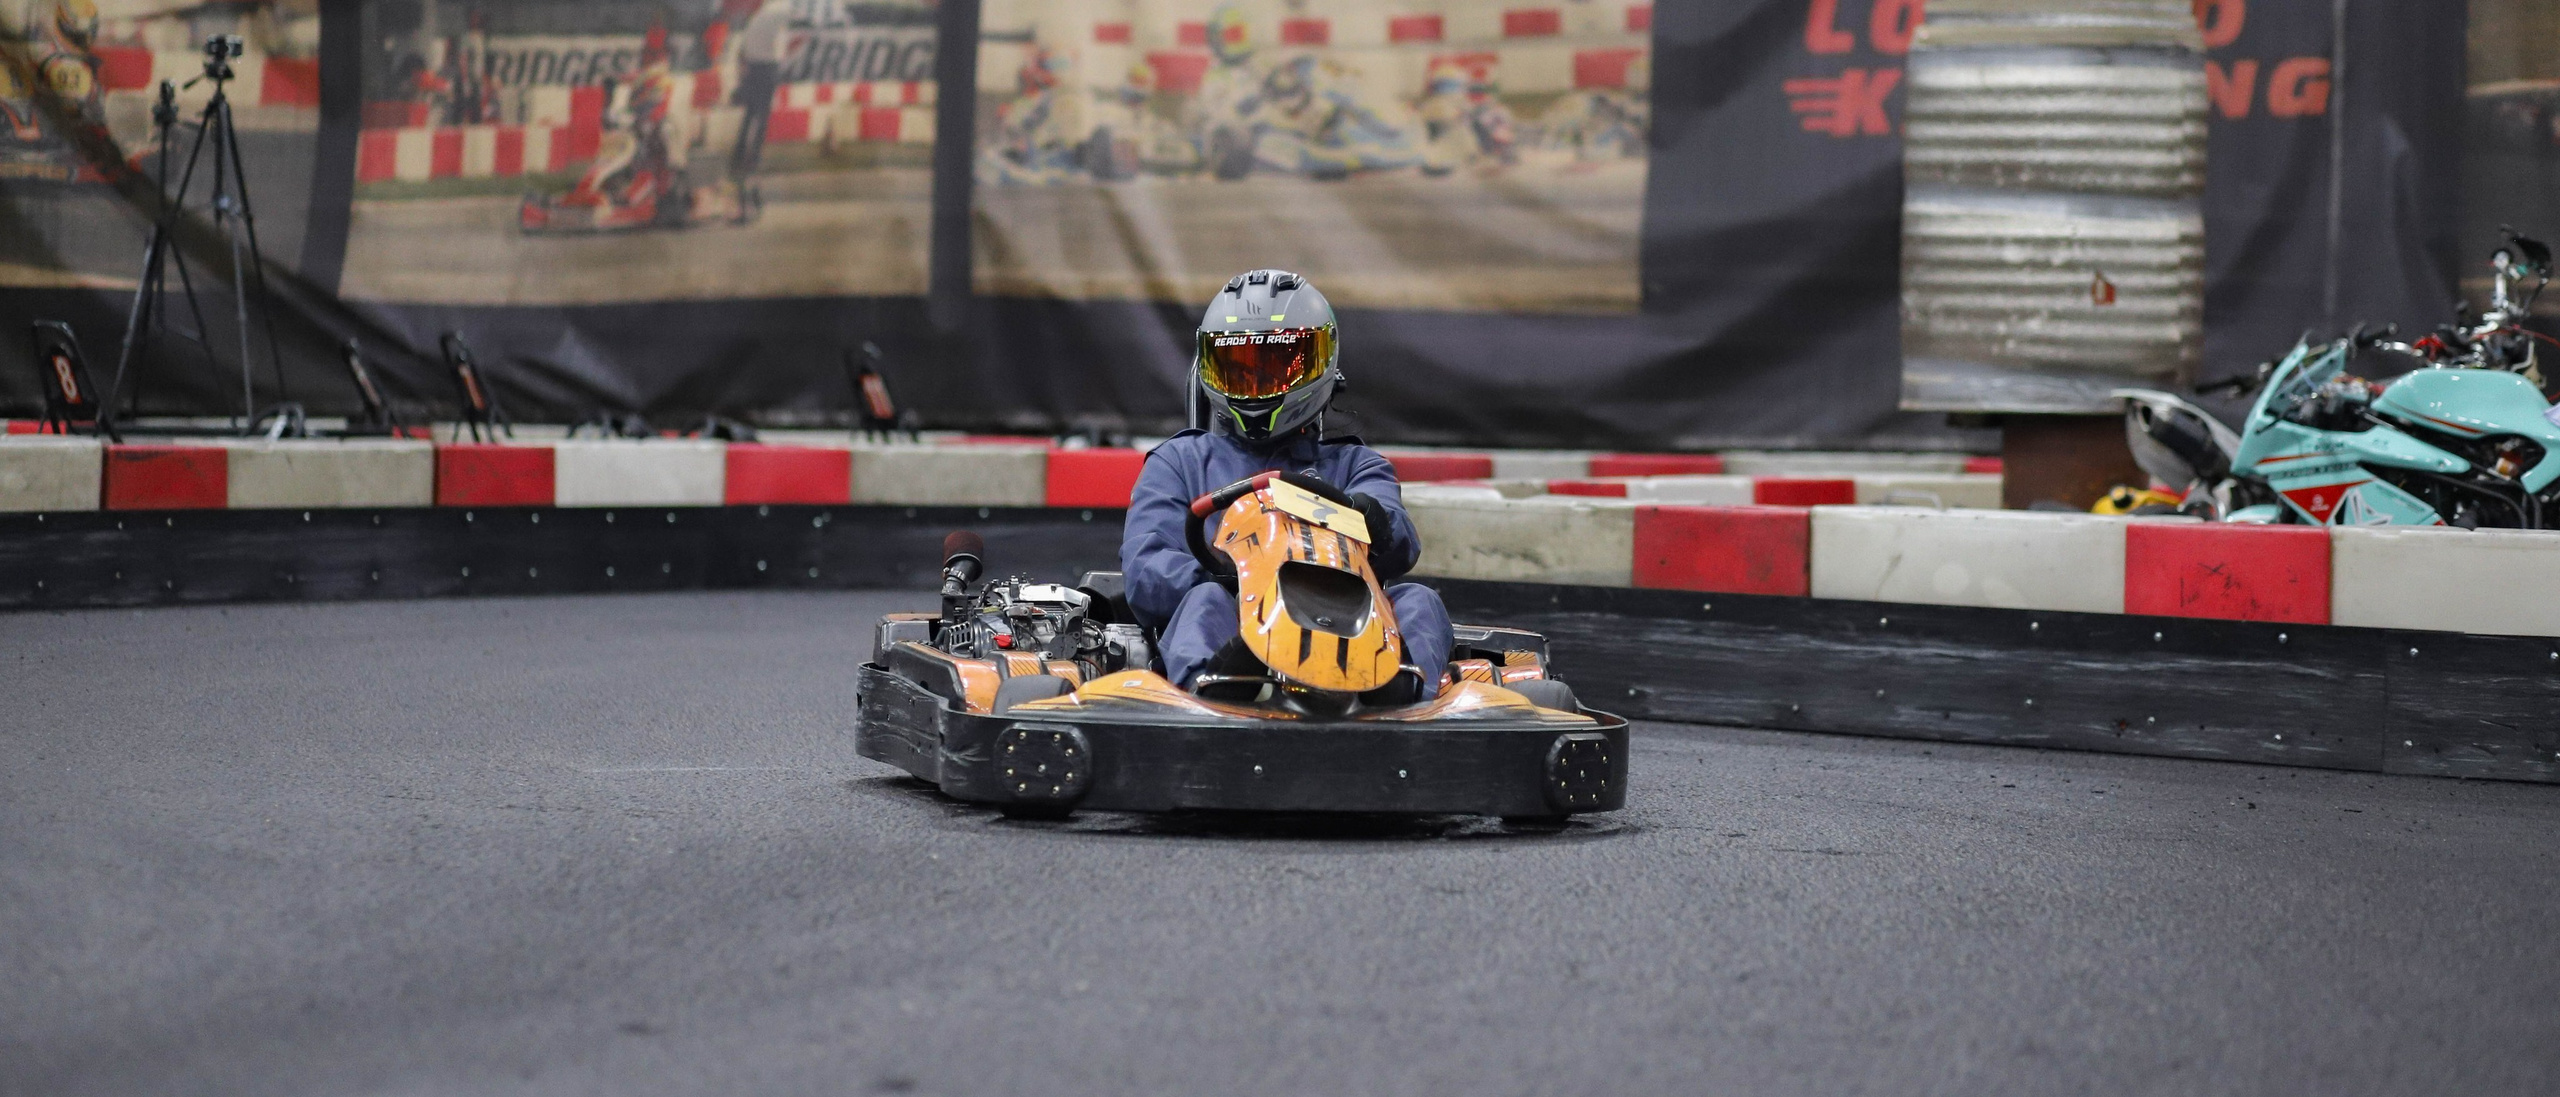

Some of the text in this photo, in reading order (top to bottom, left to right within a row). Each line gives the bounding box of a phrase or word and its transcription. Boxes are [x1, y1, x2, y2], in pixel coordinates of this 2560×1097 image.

[486, 48, 634, 87] RIDGES
[1214, 336, 1247, 347] READY
[1249, 335, 1264, 345] TO
[55, 356, 78, 400] 8
